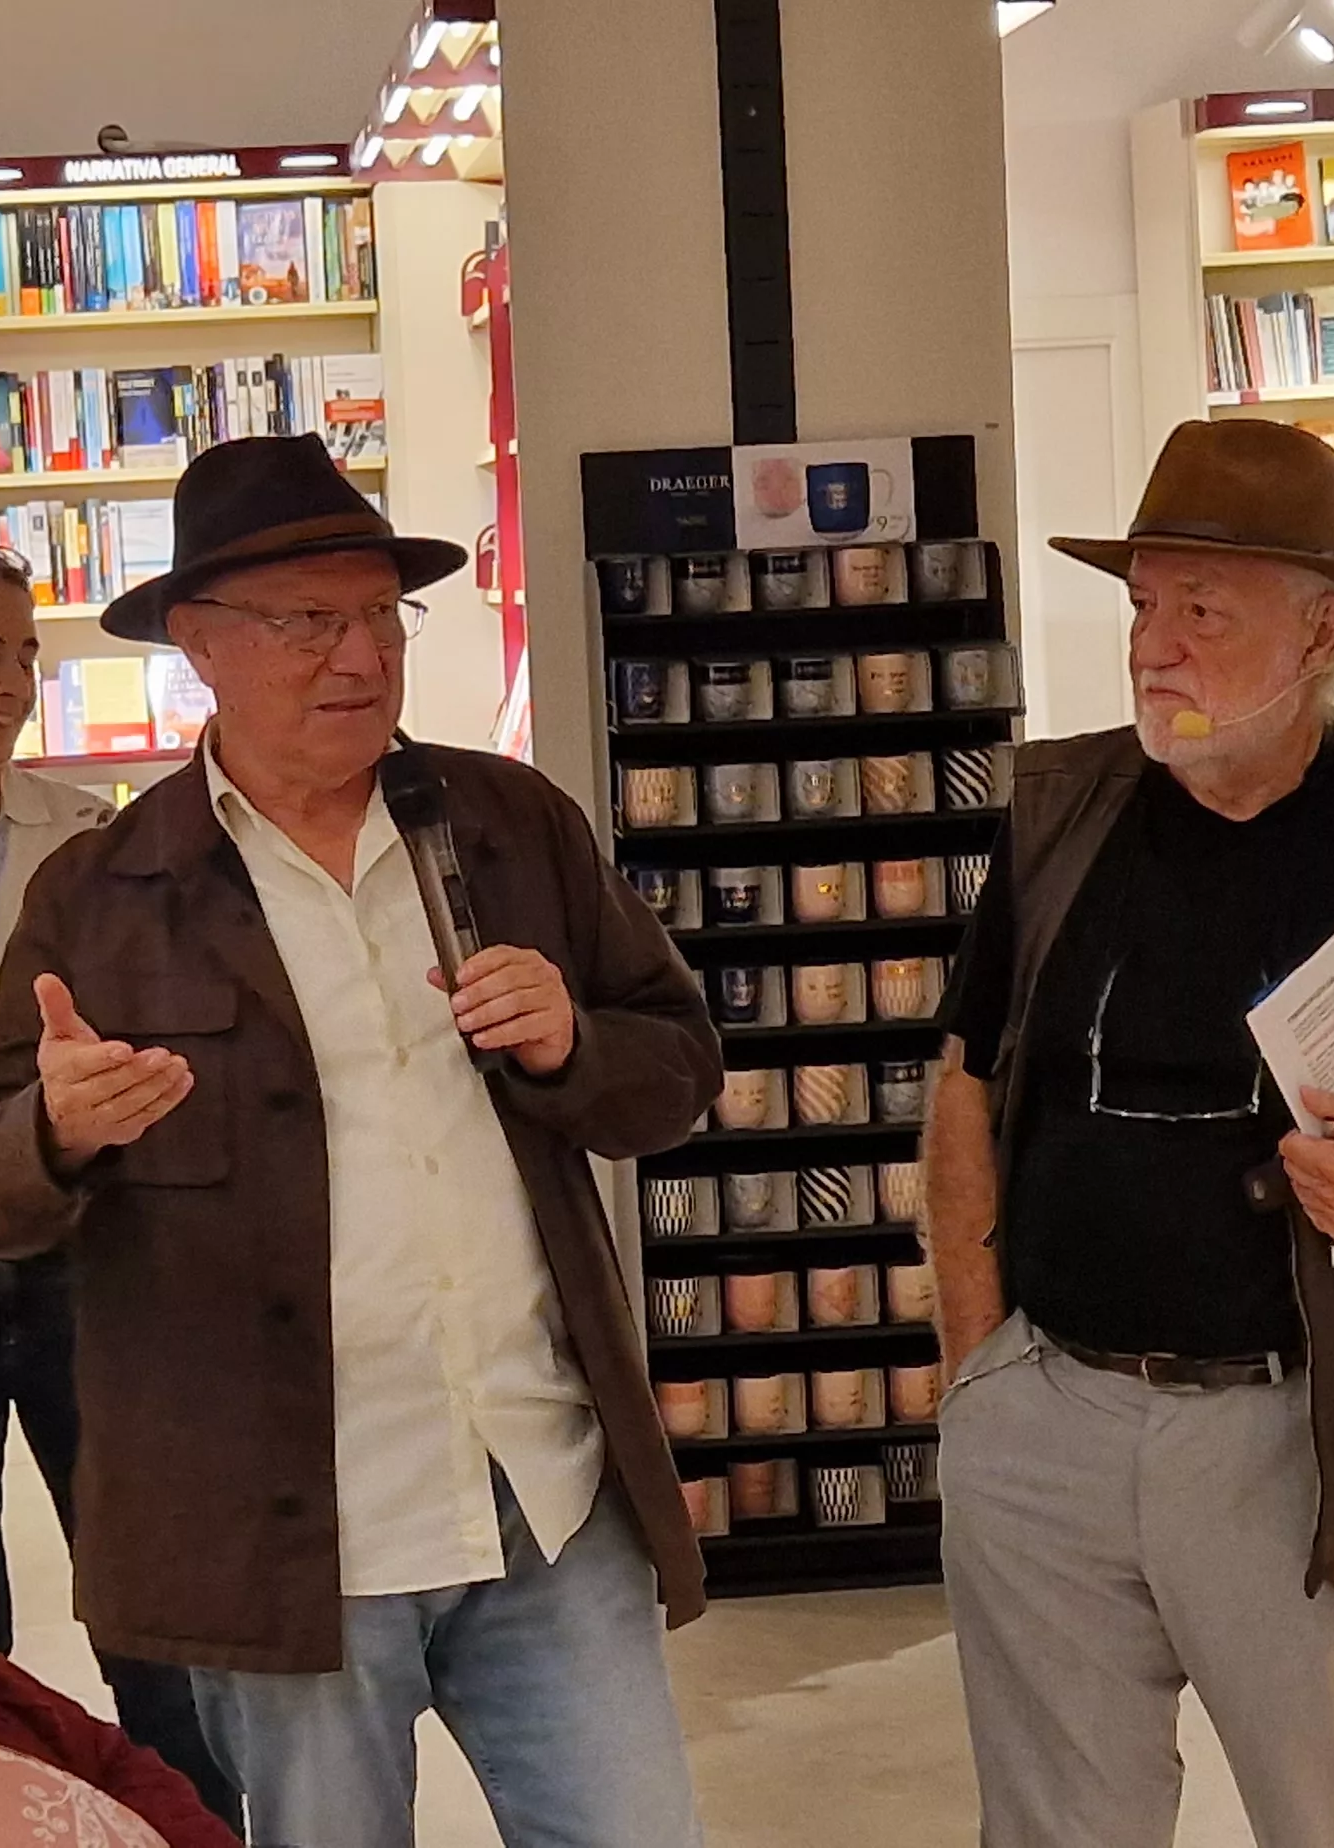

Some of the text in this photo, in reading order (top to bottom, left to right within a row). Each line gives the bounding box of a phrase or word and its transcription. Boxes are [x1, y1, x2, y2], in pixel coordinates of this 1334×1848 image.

[64, 154, 241, 183] NARRATIVA GENERAL
[650, 475, 731, 492] DRAEGER
